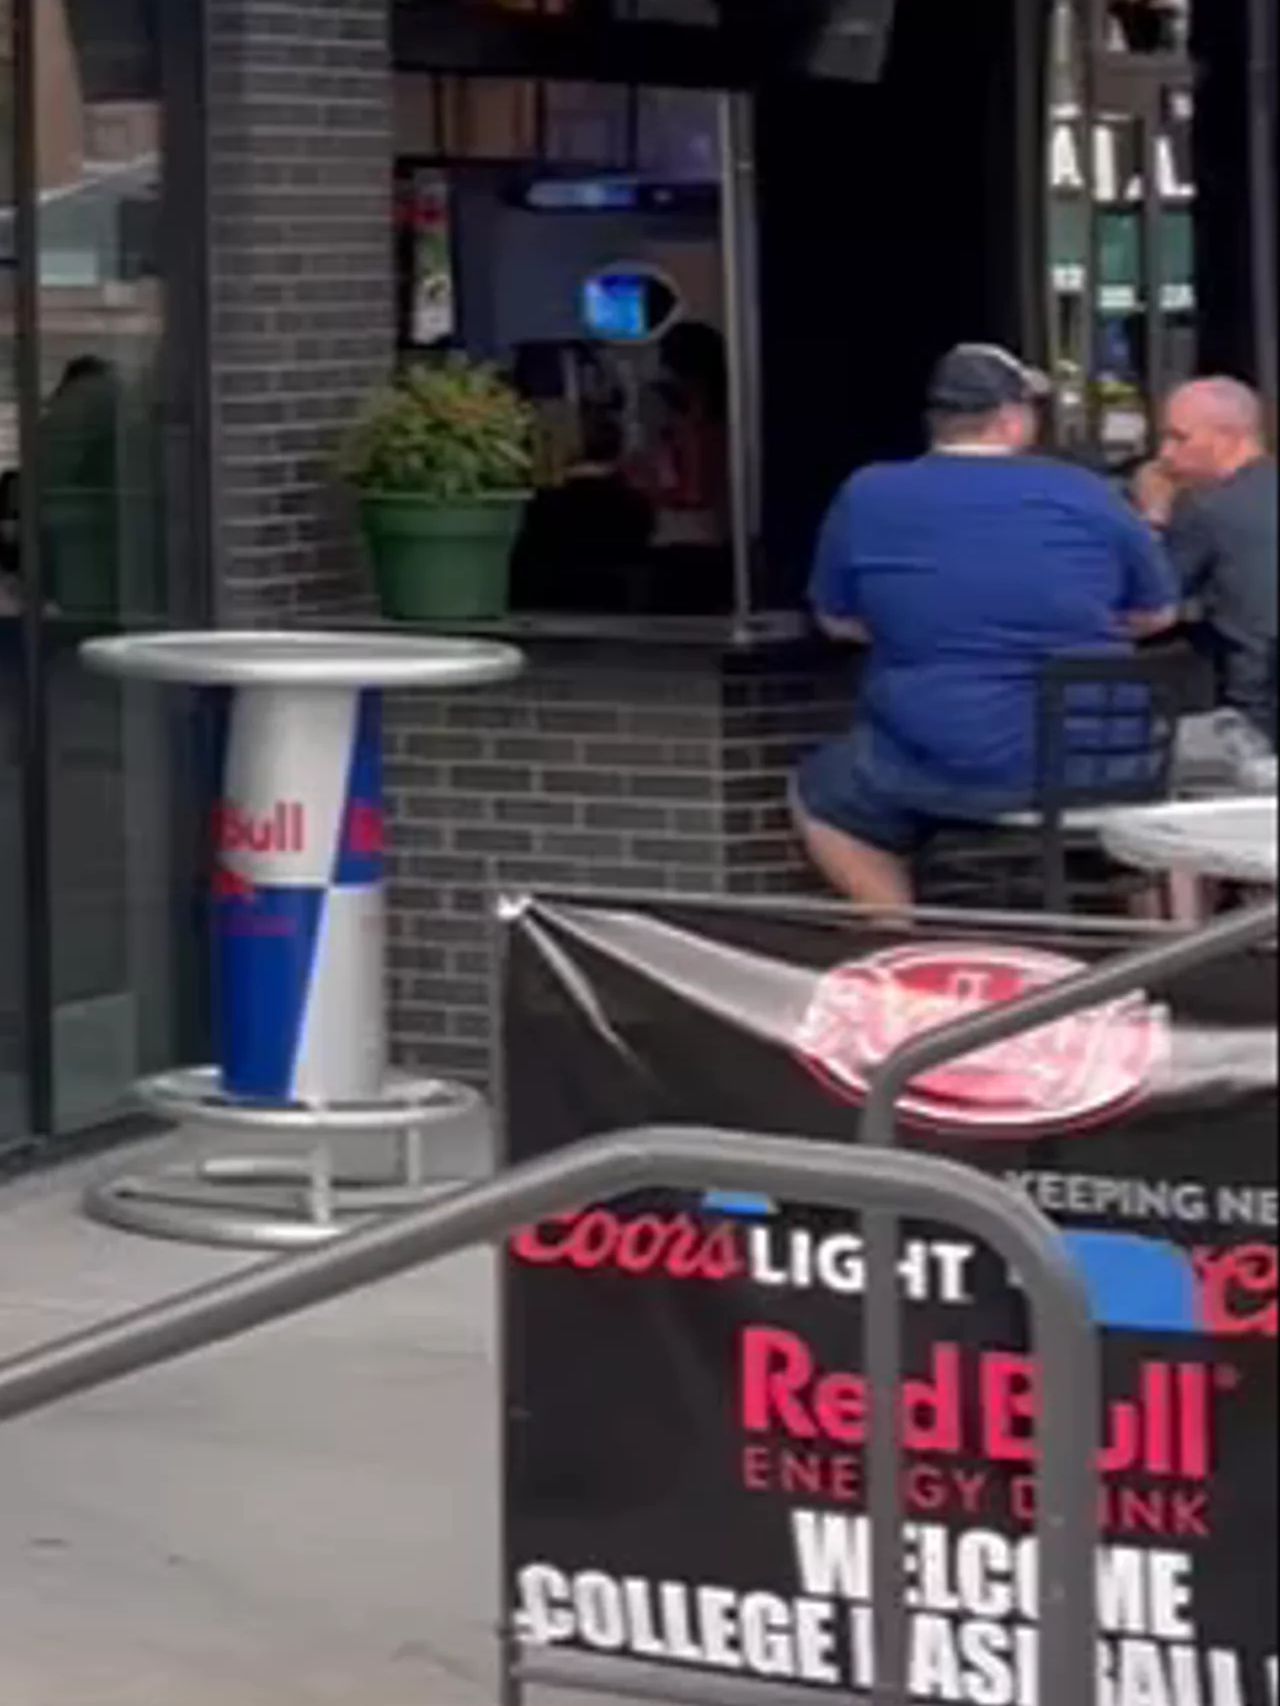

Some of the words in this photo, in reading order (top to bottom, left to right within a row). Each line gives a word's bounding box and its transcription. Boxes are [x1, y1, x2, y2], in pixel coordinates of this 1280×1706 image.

[1216, 1185, 1278, 1226] NE
[742, 1324, 960, 1451] Red
[742, 1445, 986, 1517] ENEGY
[1011, 1474, 1211, 1537] DINK
[514, 1564, 841, 1684] COLLEGE
